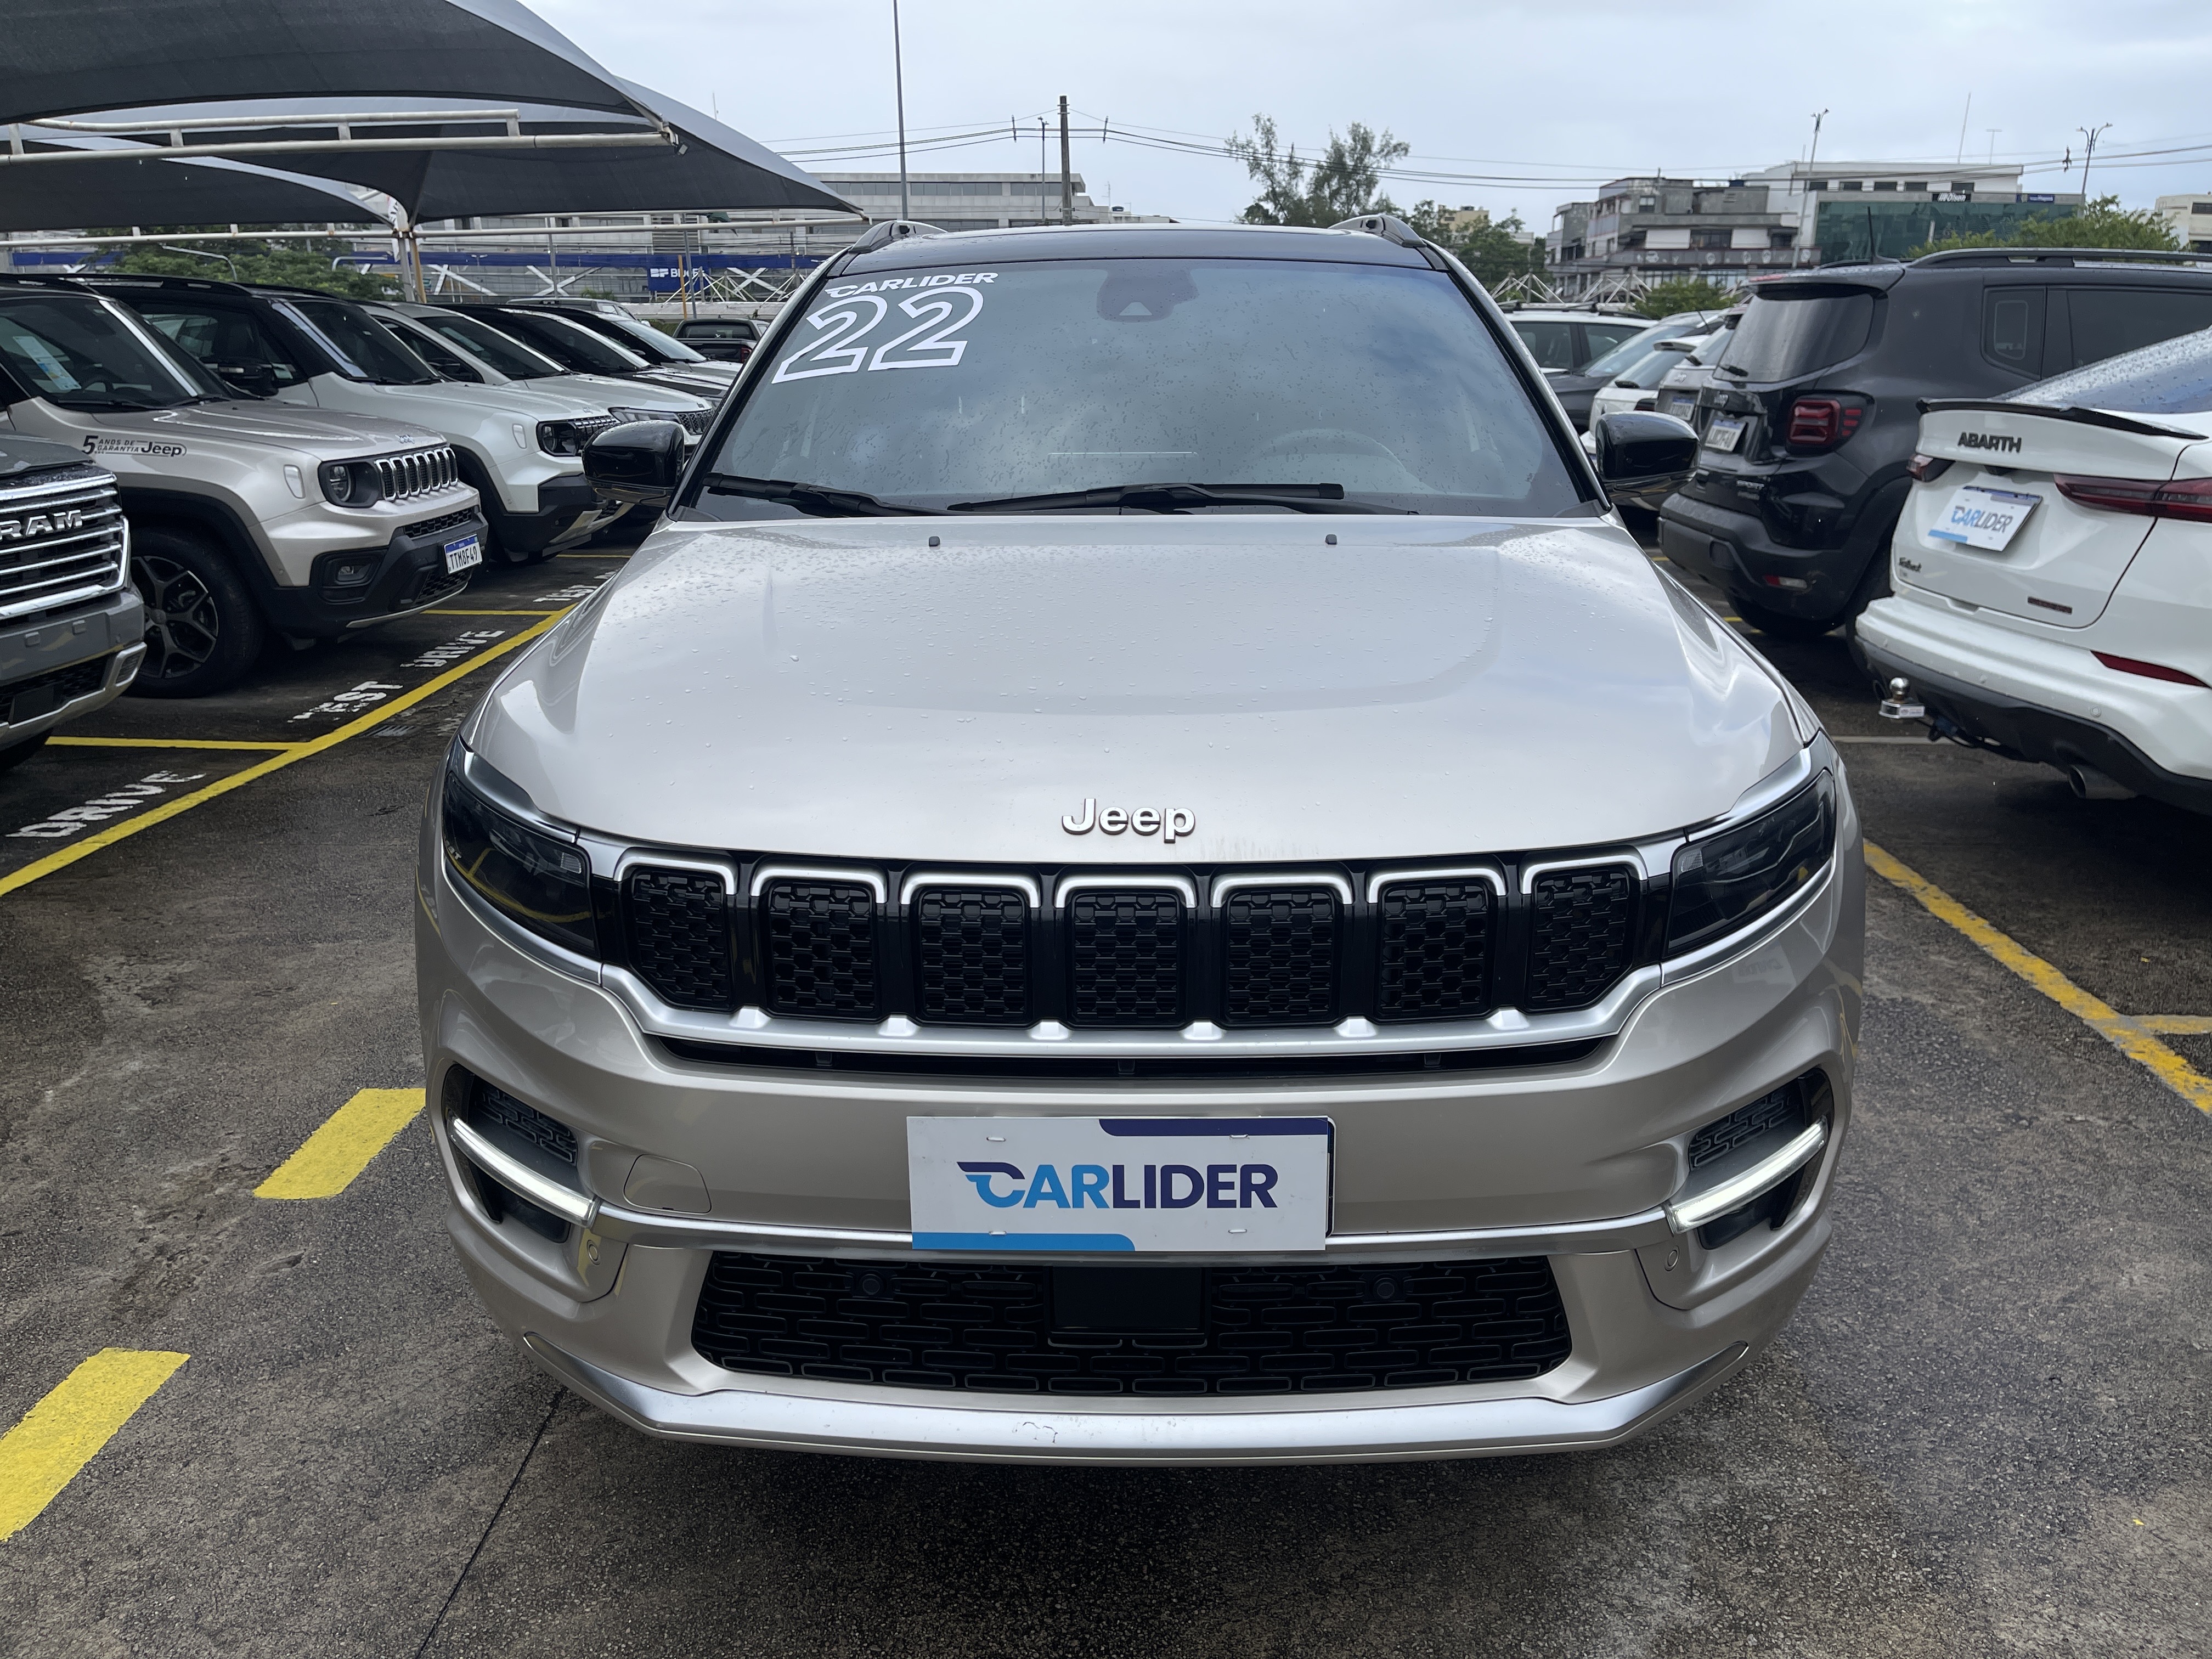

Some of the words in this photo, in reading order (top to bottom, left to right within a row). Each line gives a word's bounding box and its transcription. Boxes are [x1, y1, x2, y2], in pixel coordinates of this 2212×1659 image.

[825, 272, 998, 298] CARLIDER
[771, 286, 984, 383] 22
[82, 435, 99, 454] 5
[141, 441, 183, 457] Jeep
[1957, 432, 2022, 453] ABARTH
[0, 510, 82, 541] RAM
[1951, 505, 2013, 533] CARLIDER
[5, 770, 207, 837] DRIVE
[1062, 798, 1195, 844] Jeep
[956, 1161, 1278, 1209] CARLIDER
